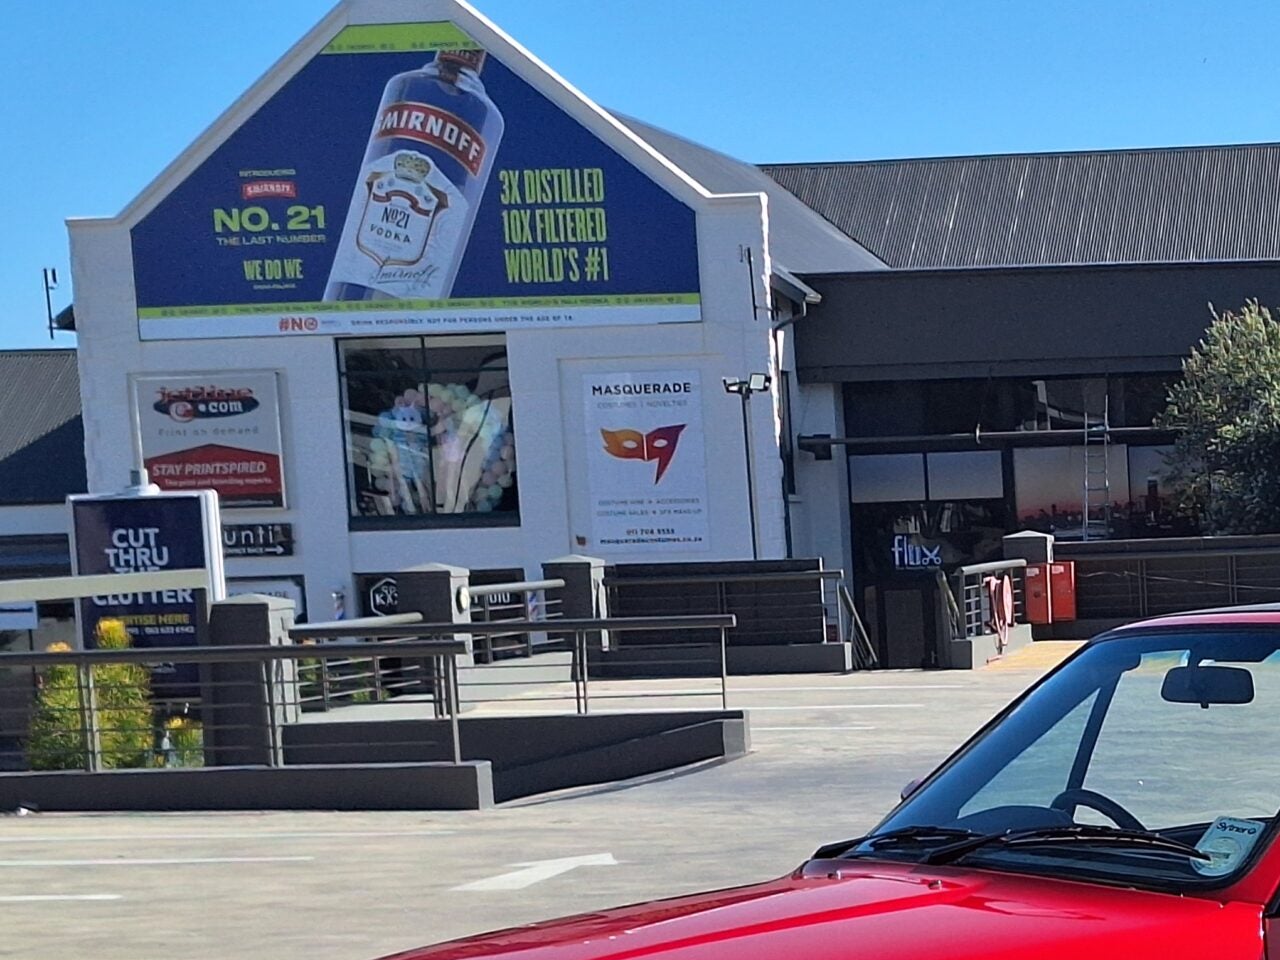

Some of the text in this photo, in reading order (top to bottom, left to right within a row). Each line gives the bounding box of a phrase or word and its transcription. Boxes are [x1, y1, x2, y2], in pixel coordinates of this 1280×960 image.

[499, 168, 604, 205] 3X DISTILLED
[213, 205, 325, 232] NO. 21
[502, 207, 607, 244] 10X FILTERED
[216, 234, 326, 246] THE LAST NUMBER
[369, 224, 412, 243] VODKA
[243, 259, 304, 280] WE DO WE
[504, 247, 609, 283] WORLD'S #1
[592, 382, 692, 396] MASQUERADE
[153, 461, 268, 477] STAY PRINTSPIRED
[112, 528, 159, 548] CUT
[224, 525, 273, 545] unti
[104, 547, 169, 567] THRU
